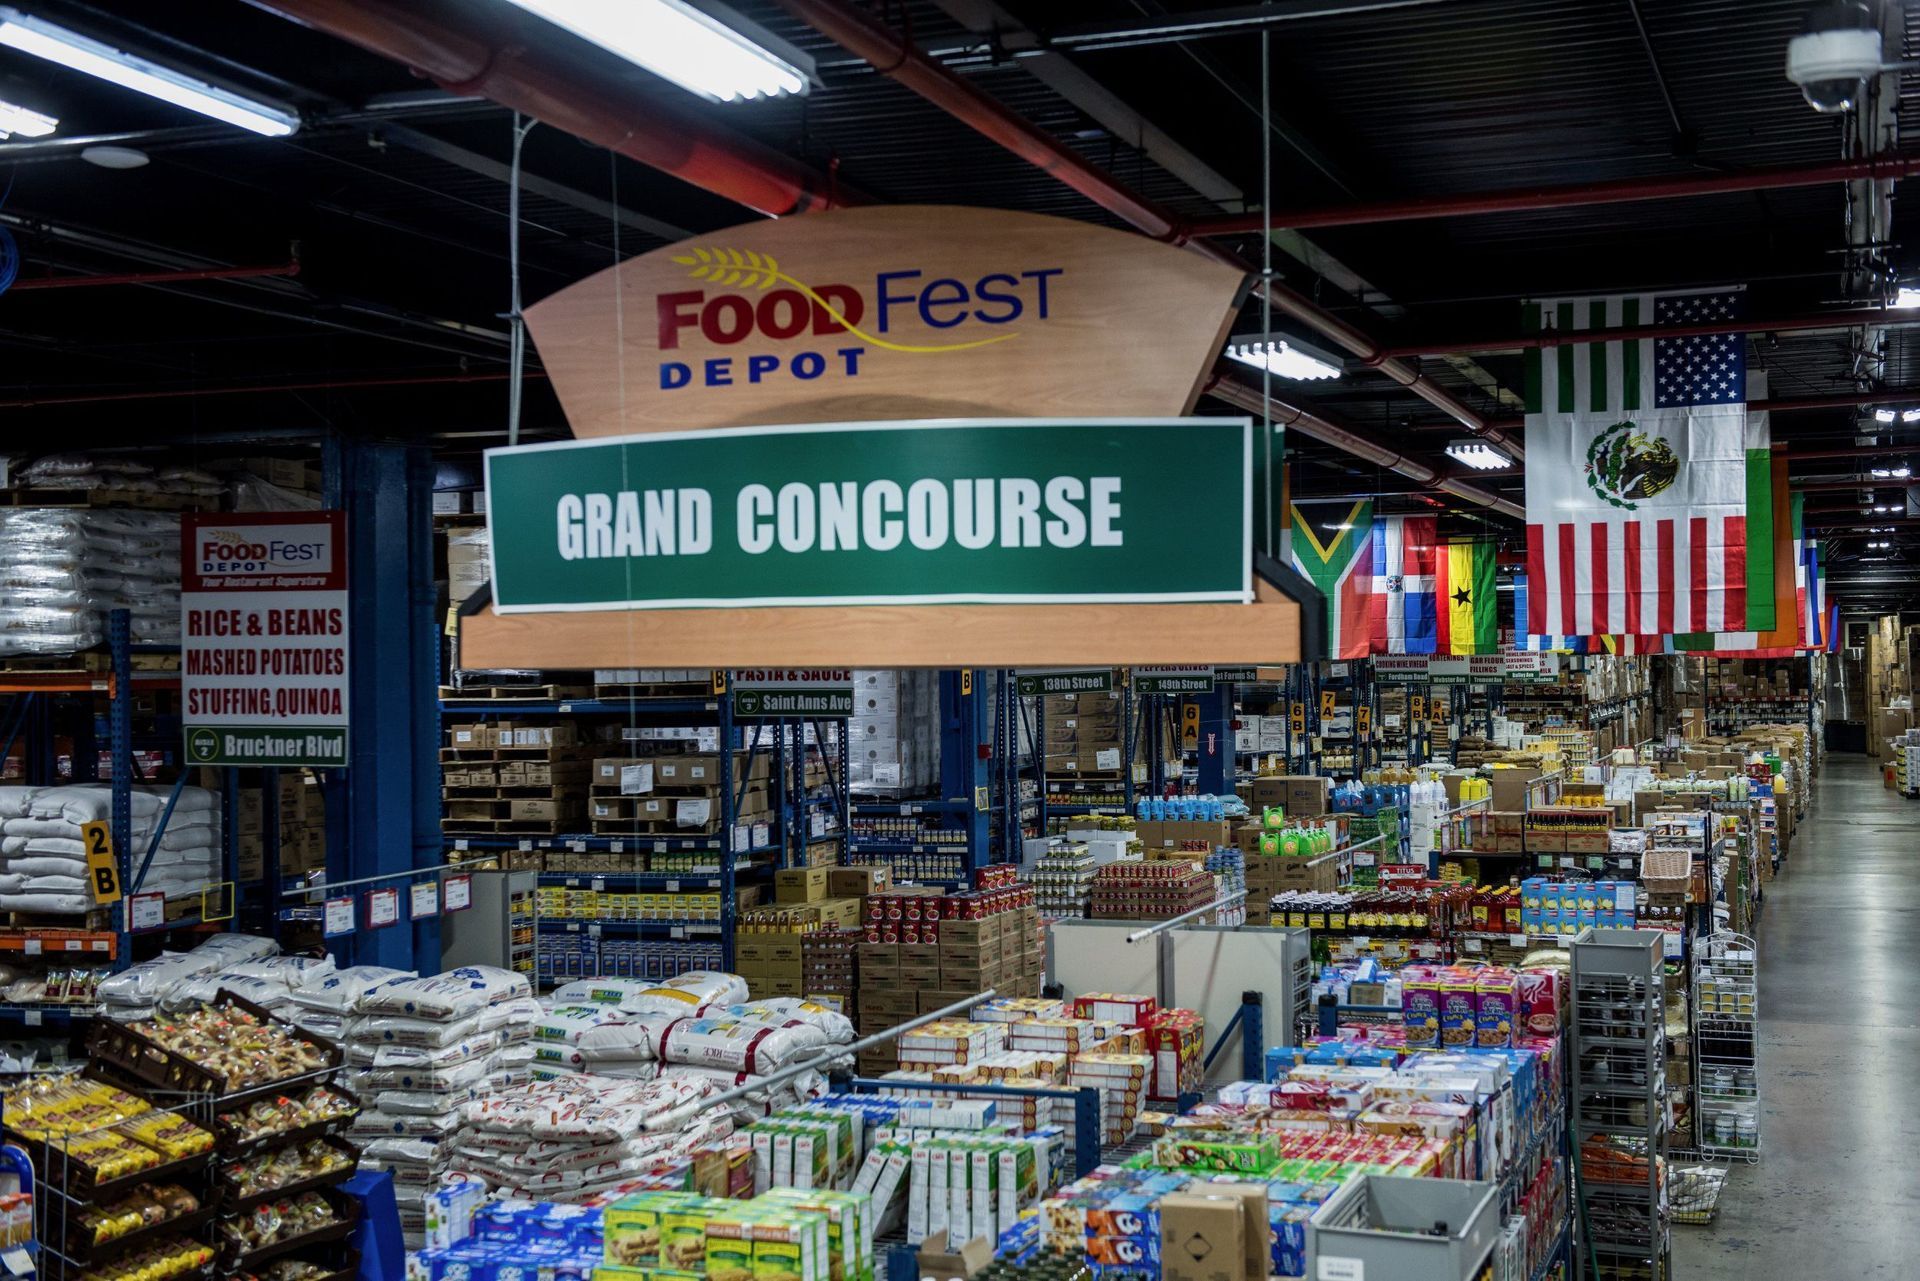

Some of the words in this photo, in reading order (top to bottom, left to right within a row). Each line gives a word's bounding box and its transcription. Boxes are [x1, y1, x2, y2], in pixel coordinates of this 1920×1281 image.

[656, 284, 864, 350] FOOD
[660, 347, 864, 390] DEPOT
[556, 488, 712, 561] GRAND
[737, 476, 1123, 554] CONCOURSE
[203, 542, 267, 561] FOOD
[203, 562, 267, 572] DEPOT
[188, 609, 242, 636] RICE
[247, 613, 263, 636] &
[268, 608, 342, 636] BEANS
[187, 649, 256, 675] MASHED
[260, 648, 344, 675] POTATOES
[963, 673, 970, 690] B
[1043, 677, 1071, 690] 138th
[1072, 676, 1104, 689] Street
[1158, 679, 1181, 690] 149th
[1181, 679, 1208, 690] Street
[763, 694, 796, 711] Saint
[797, 694, 828, 711] Anns
[829, 694, 851, 711] Ave
[1325, 693, 1334, 703] 7
[1413, 698, 1420, 707] 8
[1293, 705, 1301, 716] 6
[1434, 700, 1441, 709] 9
[1186, 707, 1196, 719] 6
[1322, 706, 1332, 717] A
[1360, 709, 1368, 719] 7
[1413, 710, 1421, 719] B
[1433, 711, 1441, 720] A
[1184, 725, 1197, 738] A
[1292, 720, 1303, 731] B
[1359, 722, 1368, 731] B
[201, 747, 209, 756] 2
[225, 734, 304, 757] Bruckner
[305, 735, 343, 757] Blvd
[89, 827, 109, 855] 2
[95, 867, 115, 894] B
